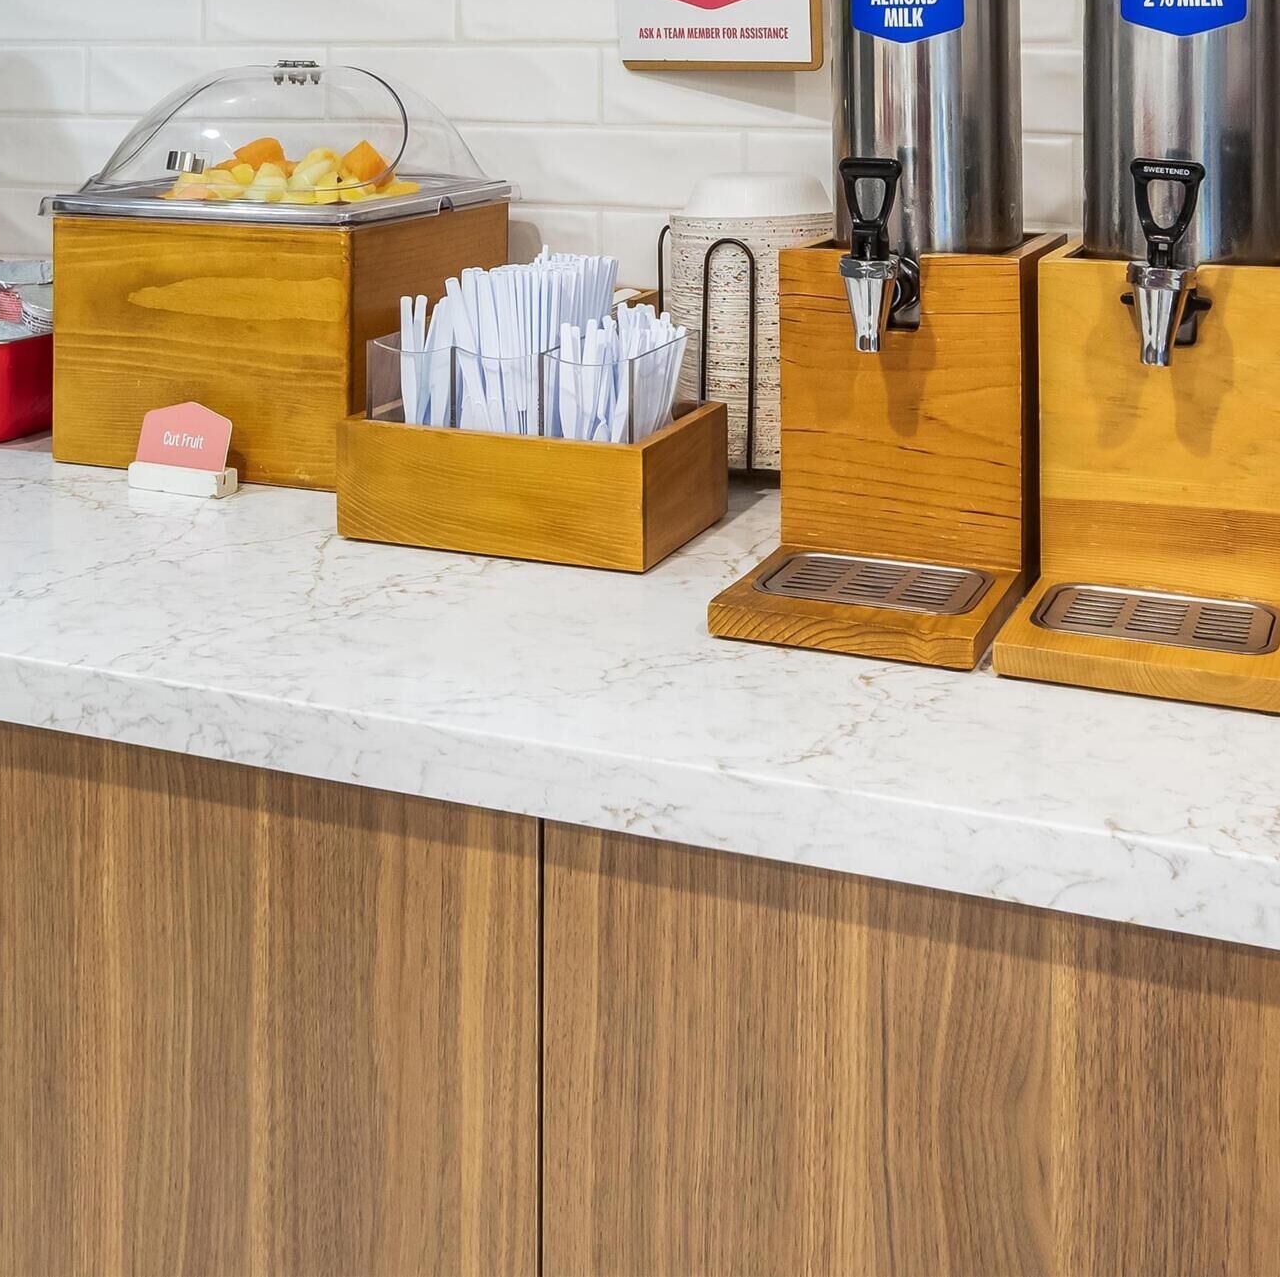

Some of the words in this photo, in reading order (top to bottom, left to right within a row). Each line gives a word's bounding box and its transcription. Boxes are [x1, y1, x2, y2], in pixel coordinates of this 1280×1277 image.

[884, 7, 924, 27] MILK
[639, 27, 654, 39] ASK
[656, 27, 662, 39] A
[664, 27, 685, 39] TEAM
[687, 27, 721, 39] MEMBER
[722, 27, 738, 39] FOR
[740, 27, 789, 39] ASSISTANCE
[1143, 165, 1190, 176] SWEETENED
[163, 430, 180, 446] Cut
[181, 433, 204, 449] Fruit
